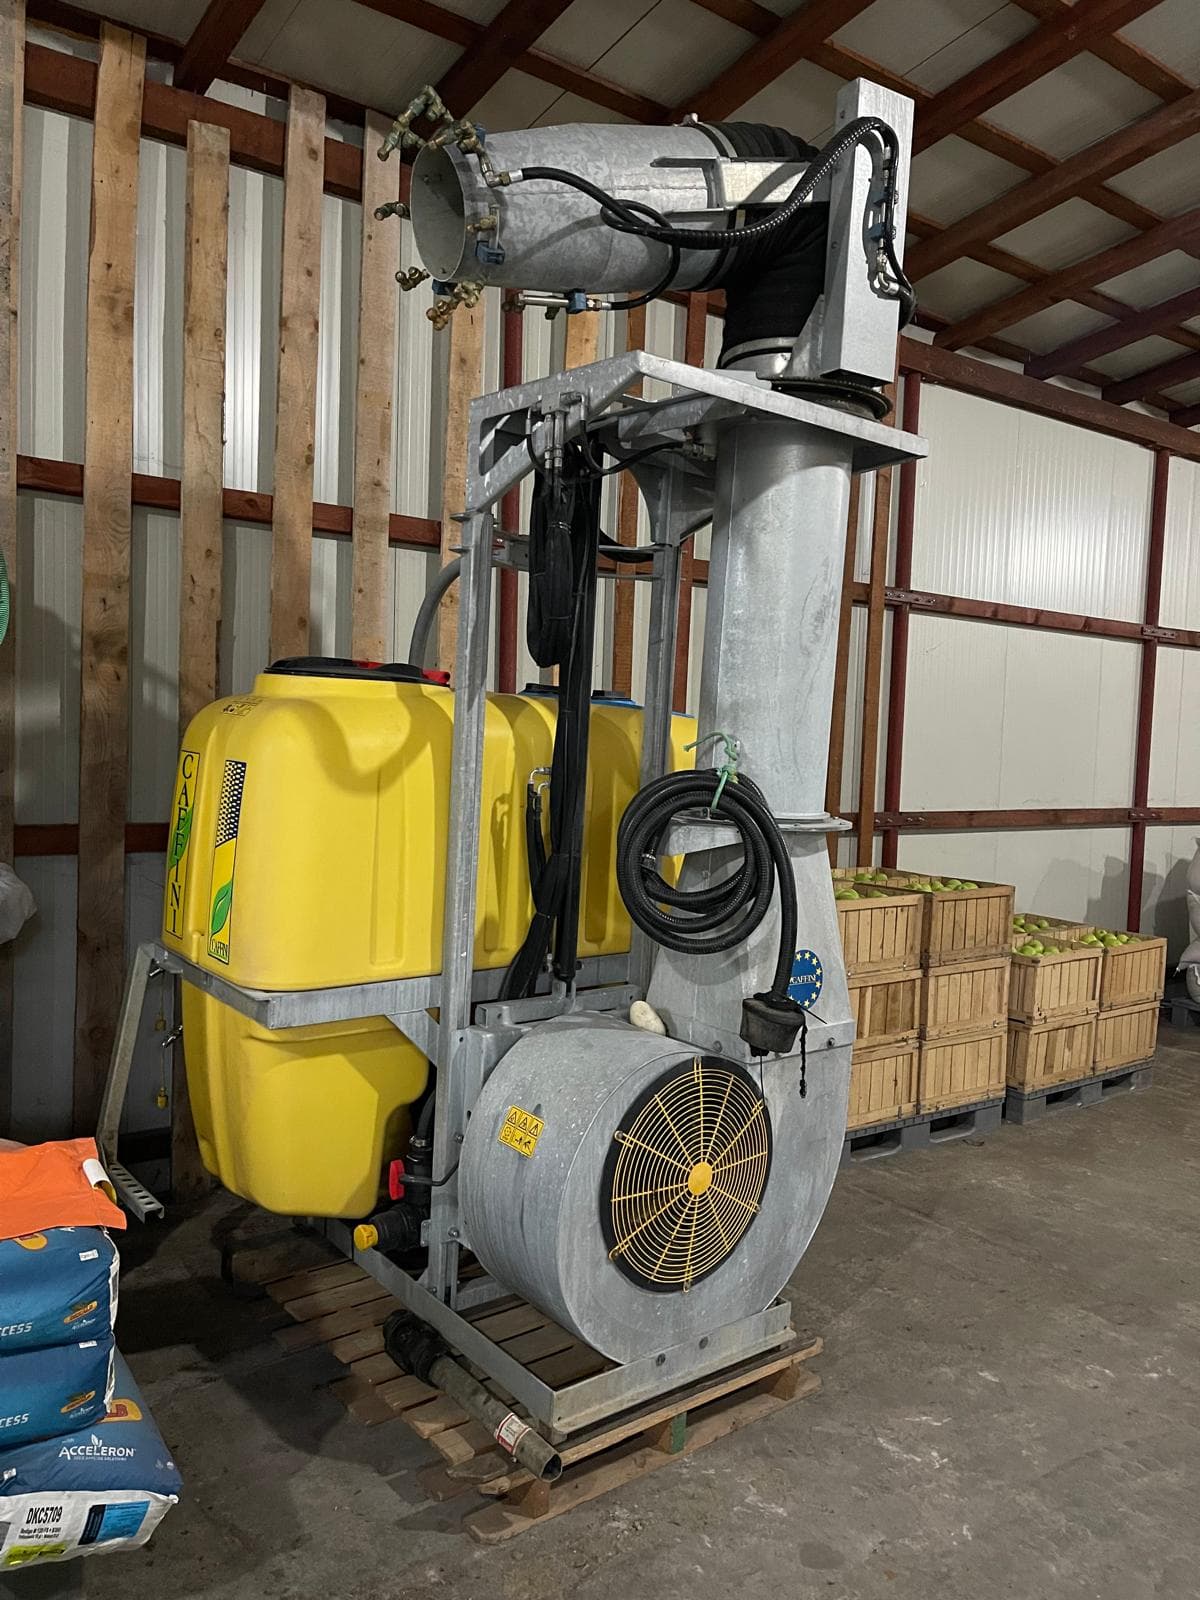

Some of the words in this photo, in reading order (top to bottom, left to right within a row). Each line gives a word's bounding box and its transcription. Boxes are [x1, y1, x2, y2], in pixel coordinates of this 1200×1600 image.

[170, 754, 194, 934] CAFFINI
[0, 1321, 33, 1337] CESS
[58, 1445, 134, 1460] ACCELERON
[26, 1506, 63, 1524] DKC5709
